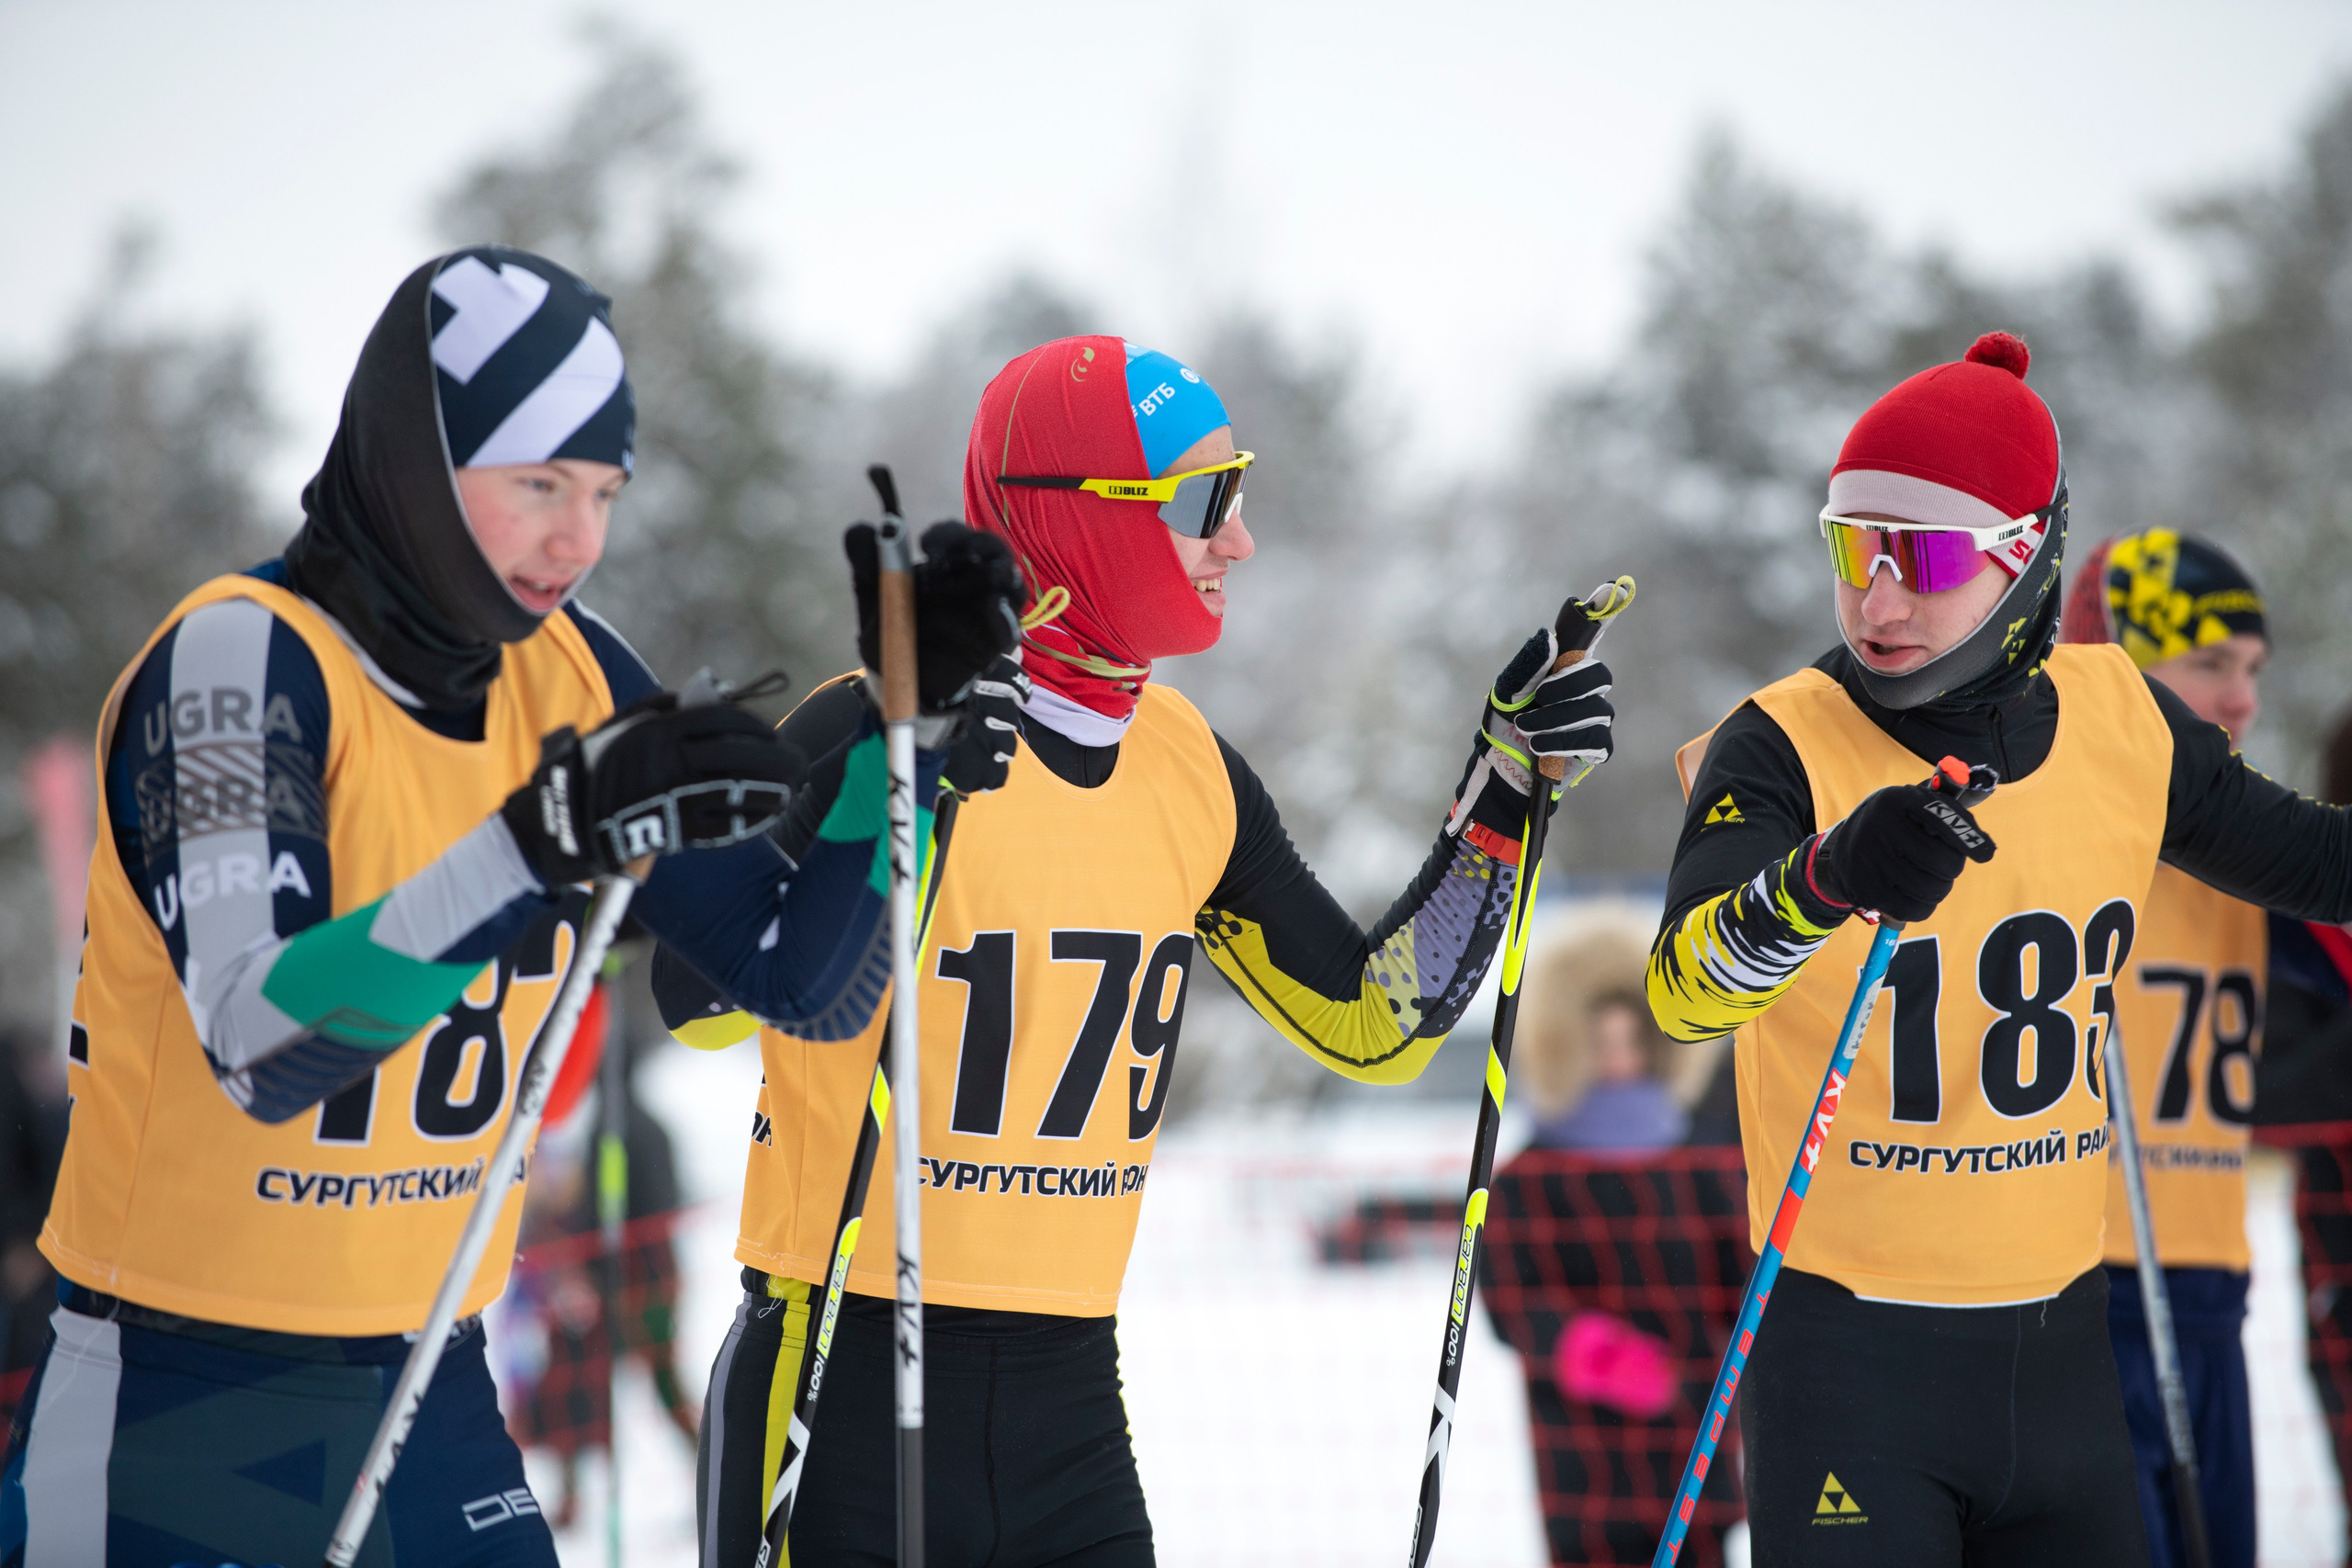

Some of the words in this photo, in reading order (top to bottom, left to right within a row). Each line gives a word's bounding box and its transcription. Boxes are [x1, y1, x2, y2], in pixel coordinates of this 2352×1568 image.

[1138, 381, 1176, 417] ВТБ
[1123, 486, 1148, 496] BLIZ
[1874, 525, 1889, 533] BLIZ
[2009, 525, 2024, 538] BLIZ
[144, 685, 303, 757] UGRA
[153, 850, 312, 931] UGRA
[1857, 897, 2135, 1123] 183
[936, 929, 1194, 1142] 179
[1849, 1128, 2066, 1175] СУРГУТСКИЙ
[256, 1156, 487, 1211] СУРГУТСКИЙ
[1811, 1516, 1870, 1526] FISCHER
